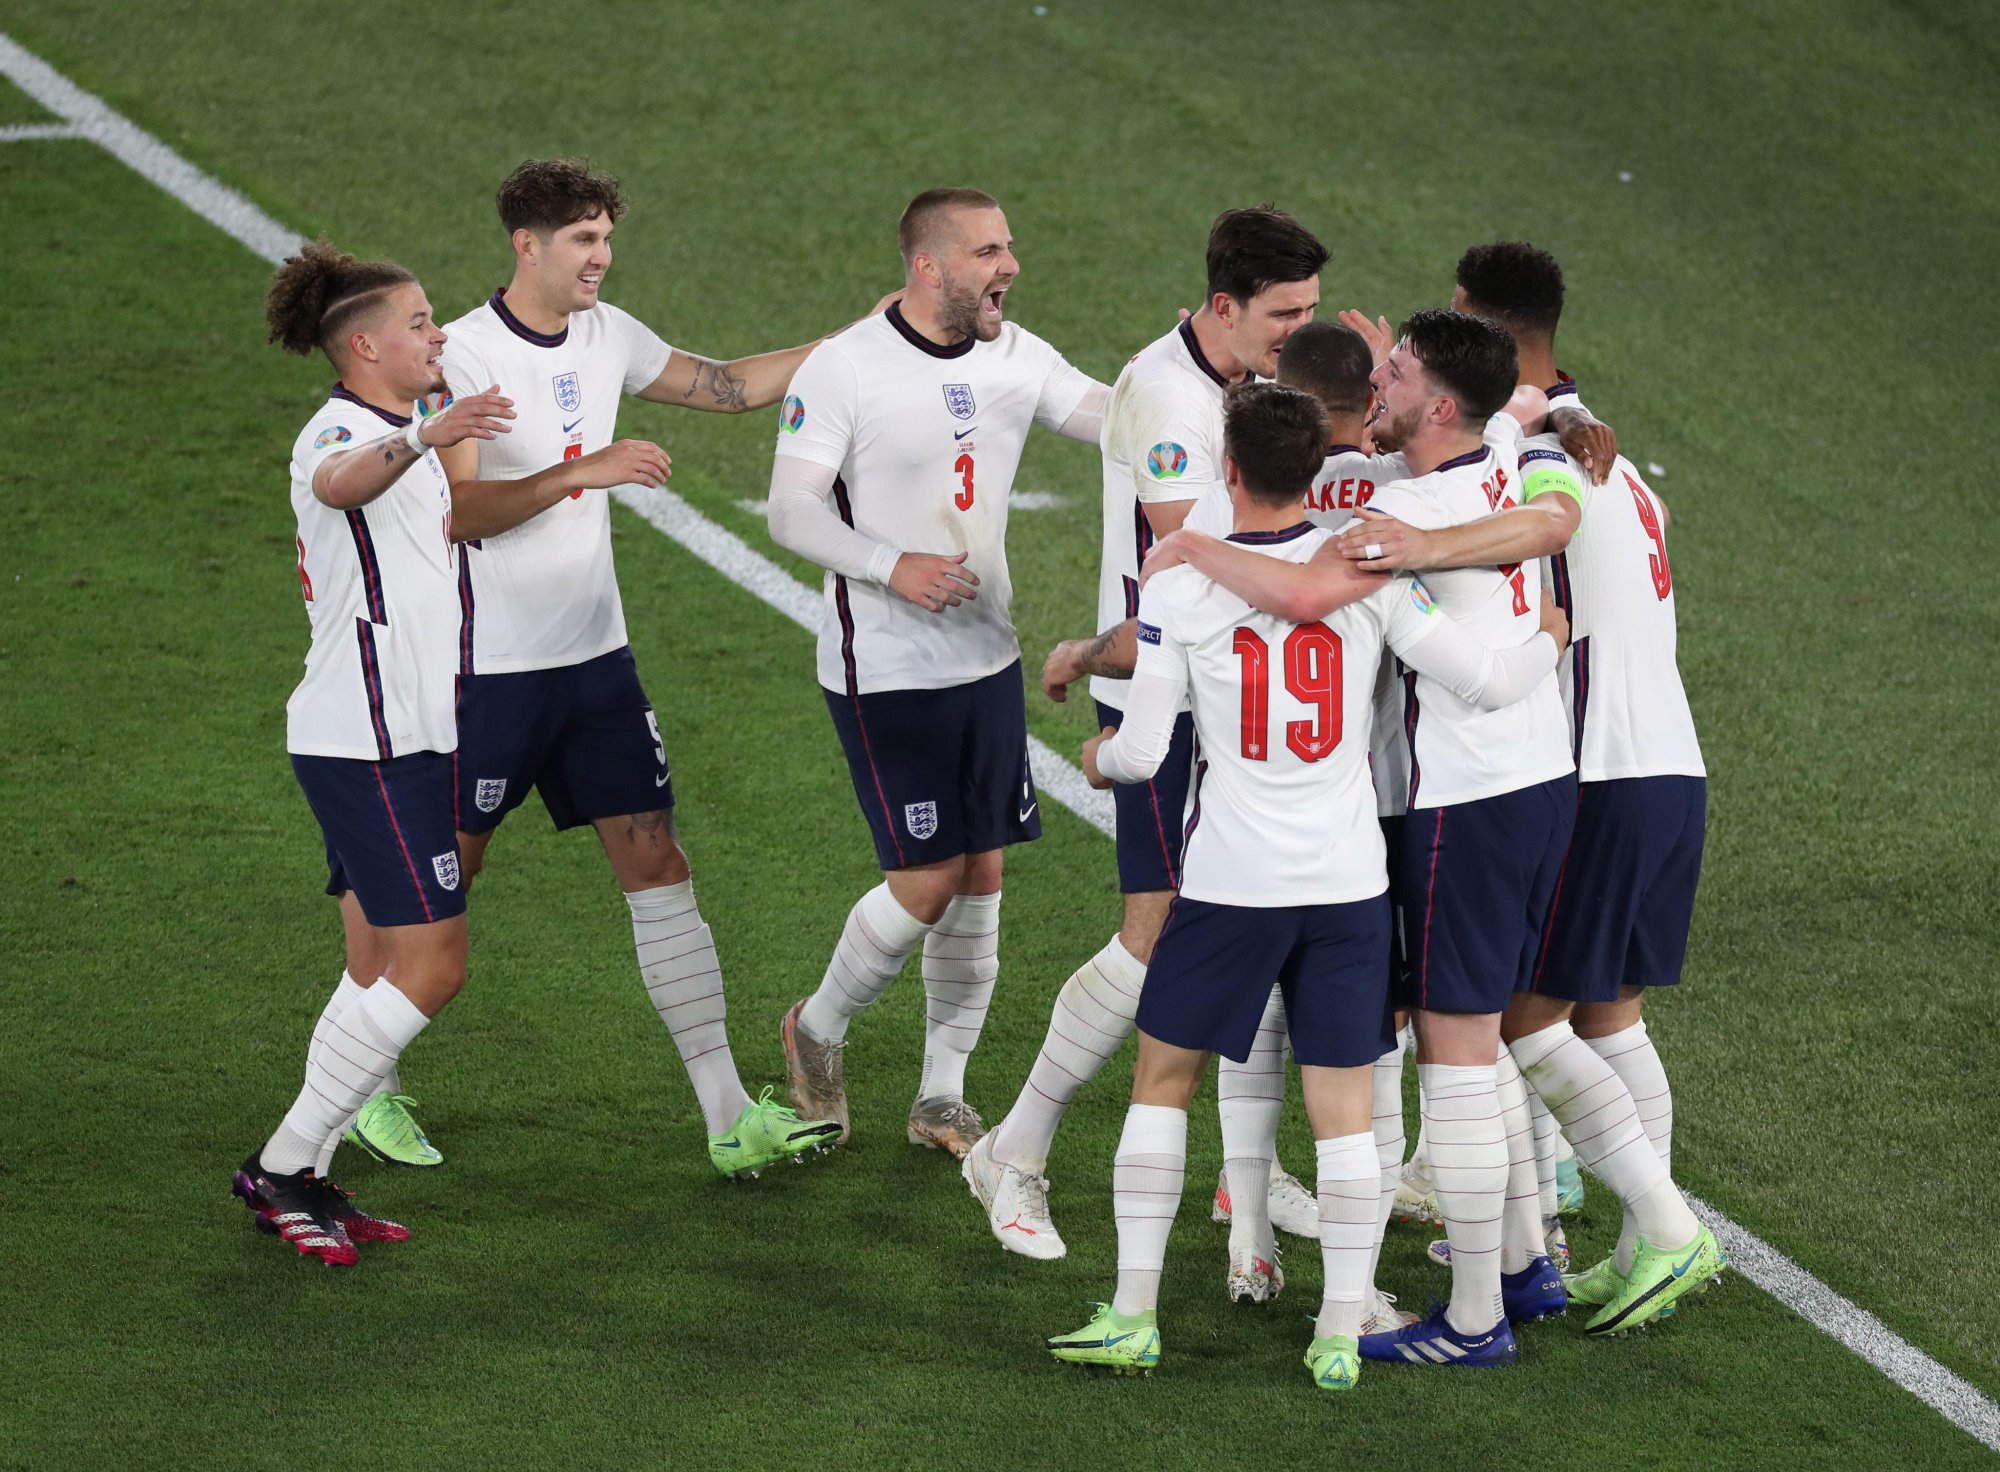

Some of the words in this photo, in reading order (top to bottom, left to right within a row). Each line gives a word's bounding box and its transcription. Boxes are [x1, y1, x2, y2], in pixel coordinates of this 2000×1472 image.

[1527, 451, 1565, 461] RESPECT
[954, 453, 975, 512] 3
[1303, 478, 1375, 513] LKER
[1138, 626, 1161, 641] ESPECT
[1232, 621, 1344, 763] 19
[644, 710, 667, 766] 5
